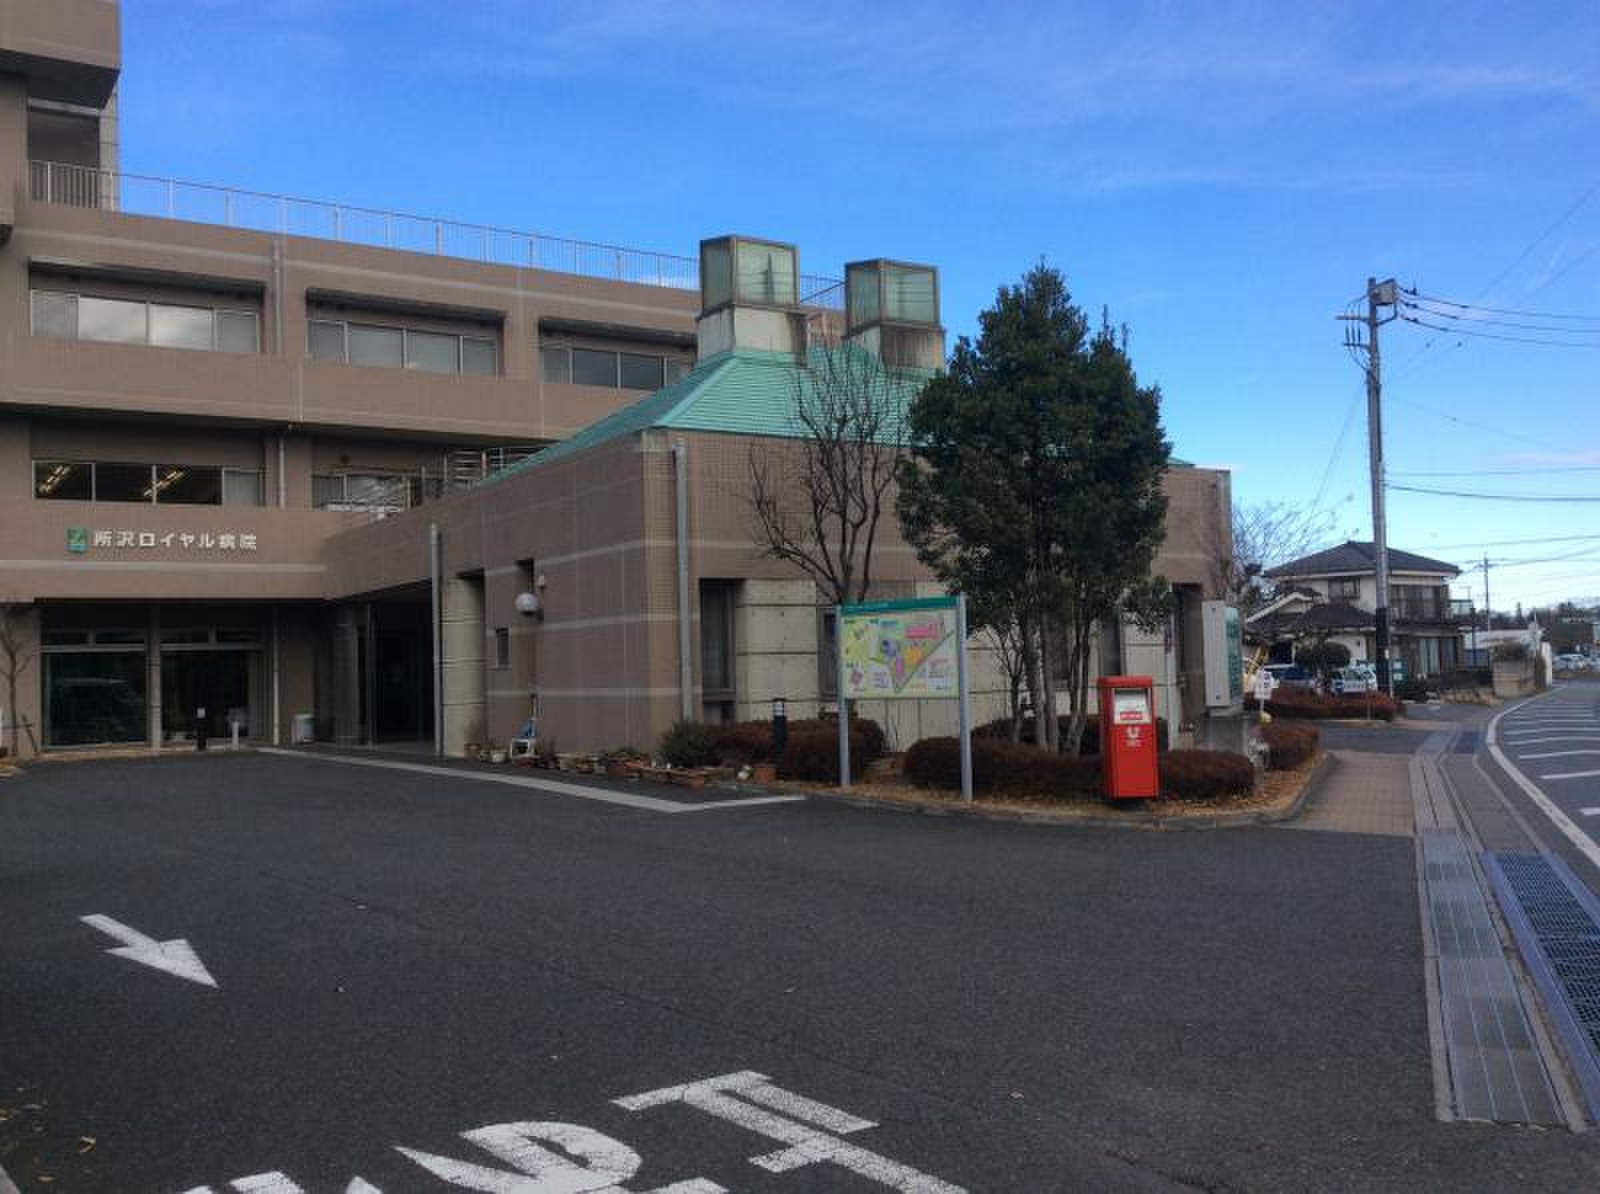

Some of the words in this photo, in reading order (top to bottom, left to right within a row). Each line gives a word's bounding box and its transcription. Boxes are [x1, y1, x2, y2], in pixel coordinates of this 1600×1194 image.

[93, 530, 257, 550] 所沢ロイヤル病院
